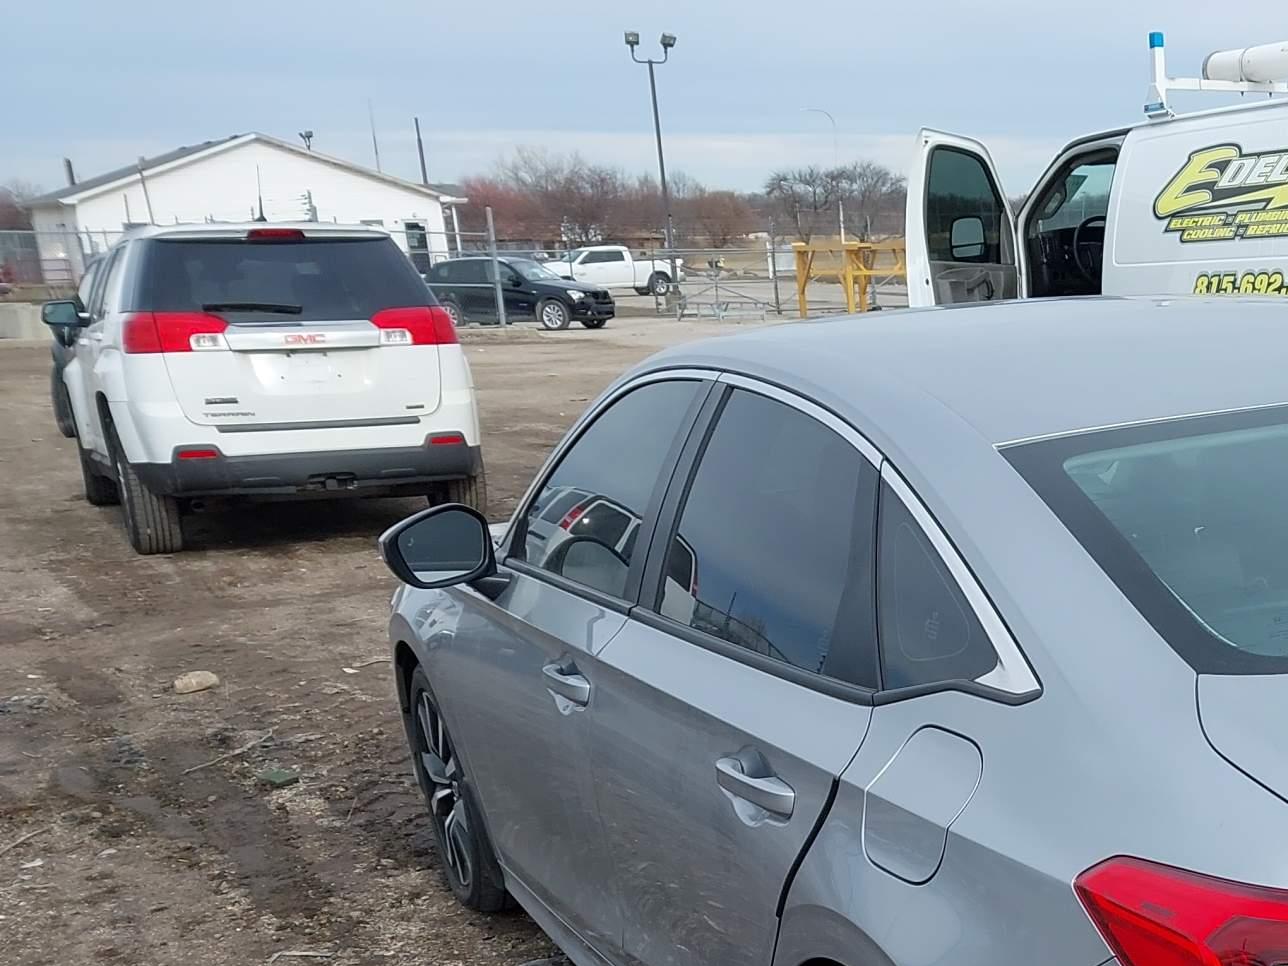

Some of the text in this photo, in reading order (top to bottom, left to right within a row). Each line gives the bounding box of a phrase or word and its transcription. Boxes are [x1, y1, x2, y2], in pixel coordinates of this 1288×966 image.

[1169, 216, 1225, 228] ELECTRIC
[1183, 227, 1235, 240] COOLING
[284, 334, 327, 345] GMC
